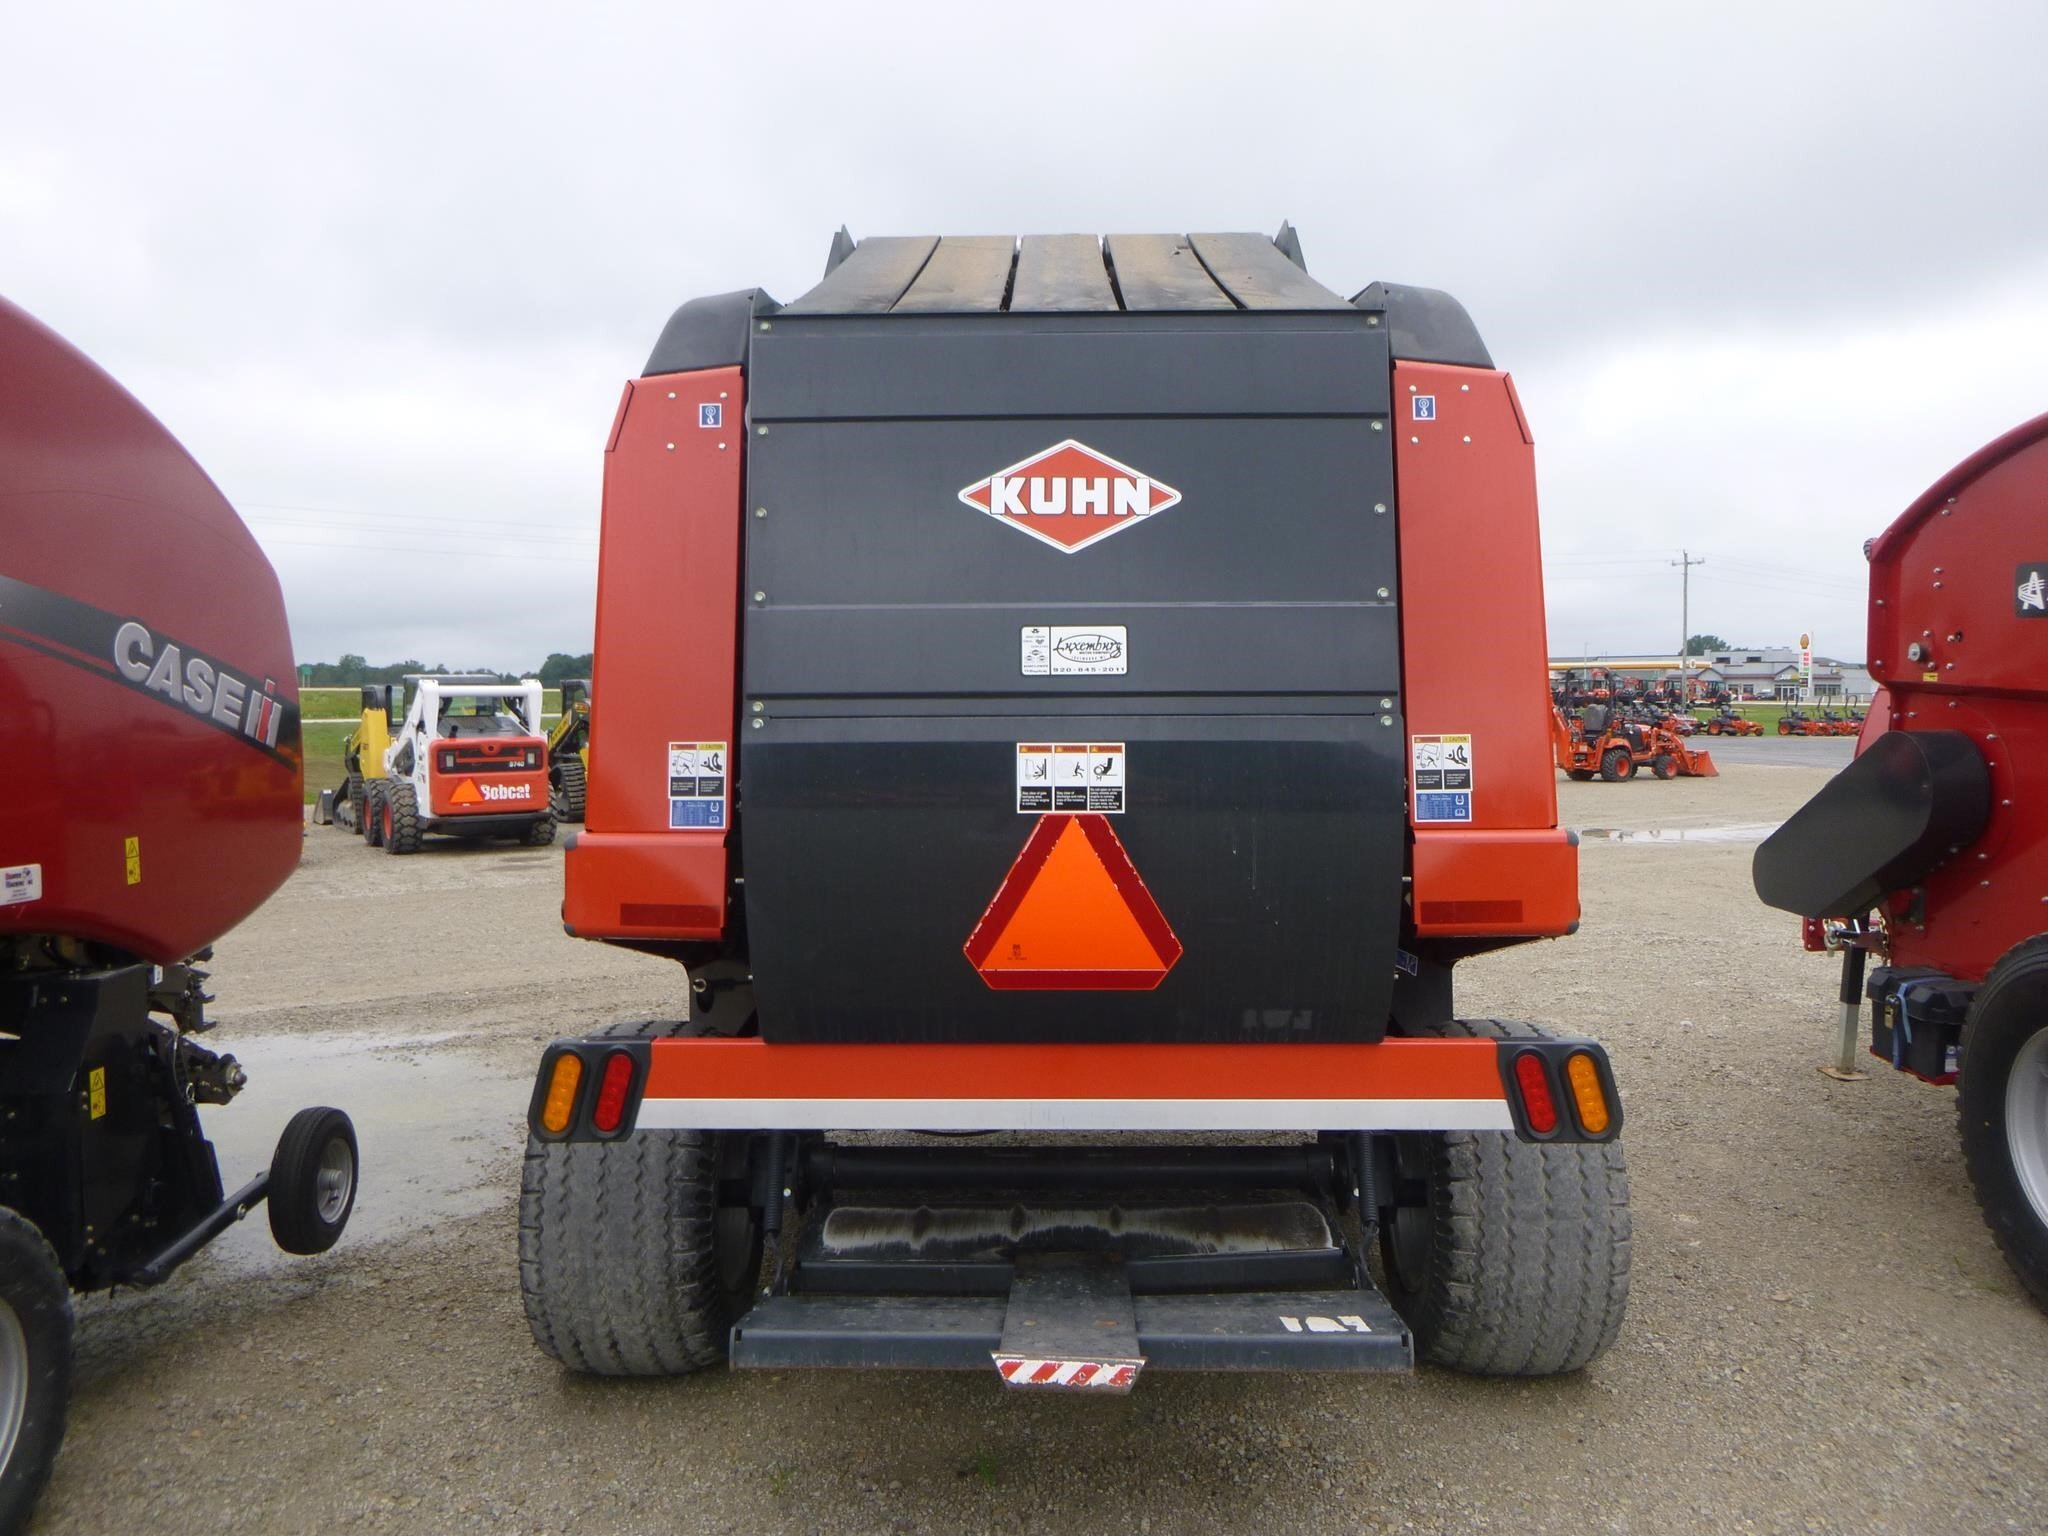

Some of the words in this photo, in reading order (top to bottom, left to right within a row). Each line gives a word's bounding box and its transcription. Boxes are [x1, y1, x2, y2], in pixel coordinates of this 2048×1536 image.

[990, 477, 1150, 515] KUHN
[1053, 636, 1122, 659] Luxemburg
[480, 784, 531, 800] Bobcat
